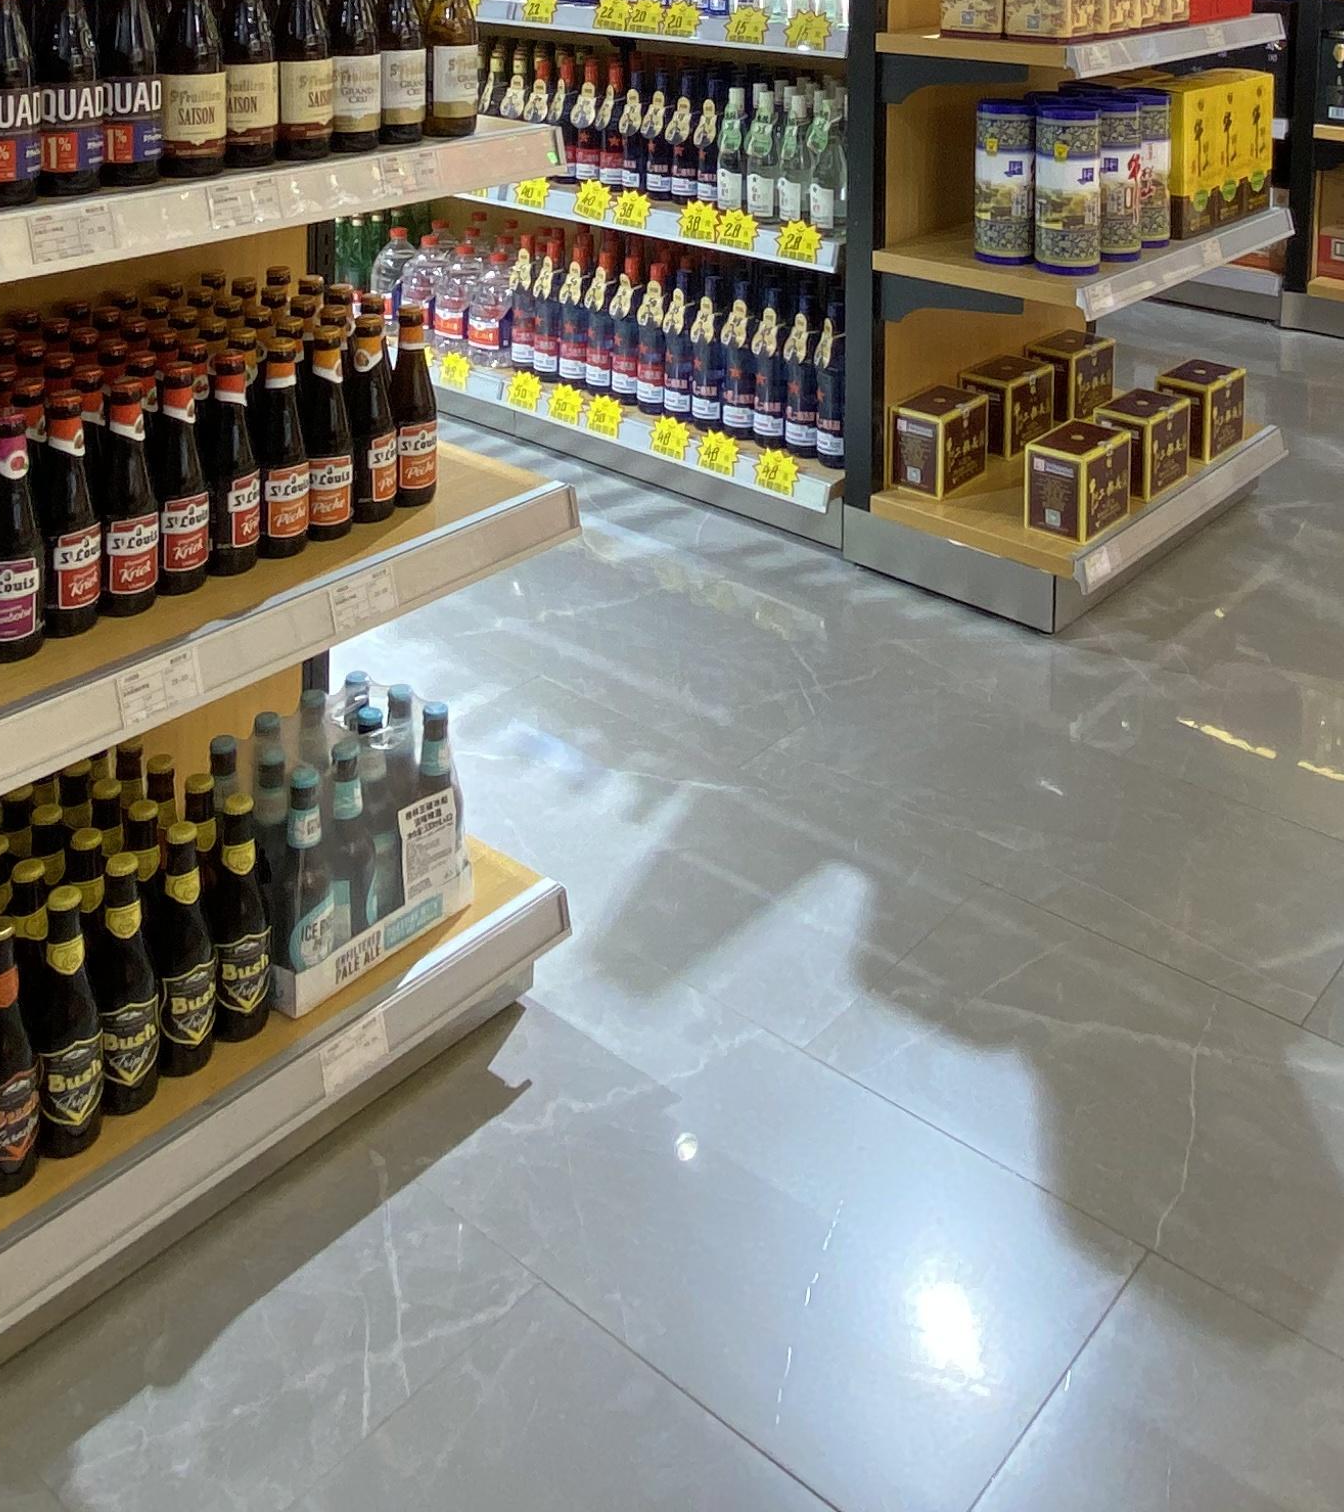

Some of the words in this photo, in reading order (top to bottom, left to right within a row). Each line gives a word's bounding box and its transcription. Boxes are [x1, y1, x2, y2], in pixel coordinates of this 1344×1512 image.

[42, 86, 105, 124] QUAD
[104, 81, 162, 115] QUAD
[226, 96, 258, 114] AISON
[177, 106, 216, 126] SAISON
[319, 470, 350, 485] Louis
[119, 560, 152, 584] Kriek
[222, 953, 269, 981] Bush
[335, 960, 360, 985] PALE
[363, 945, 381, 966] ALE
[171, 982, 216, 1015] Bush
[102, 1023, 156, 1052] Bush
[48, 1059, 103, 1093] Bush
